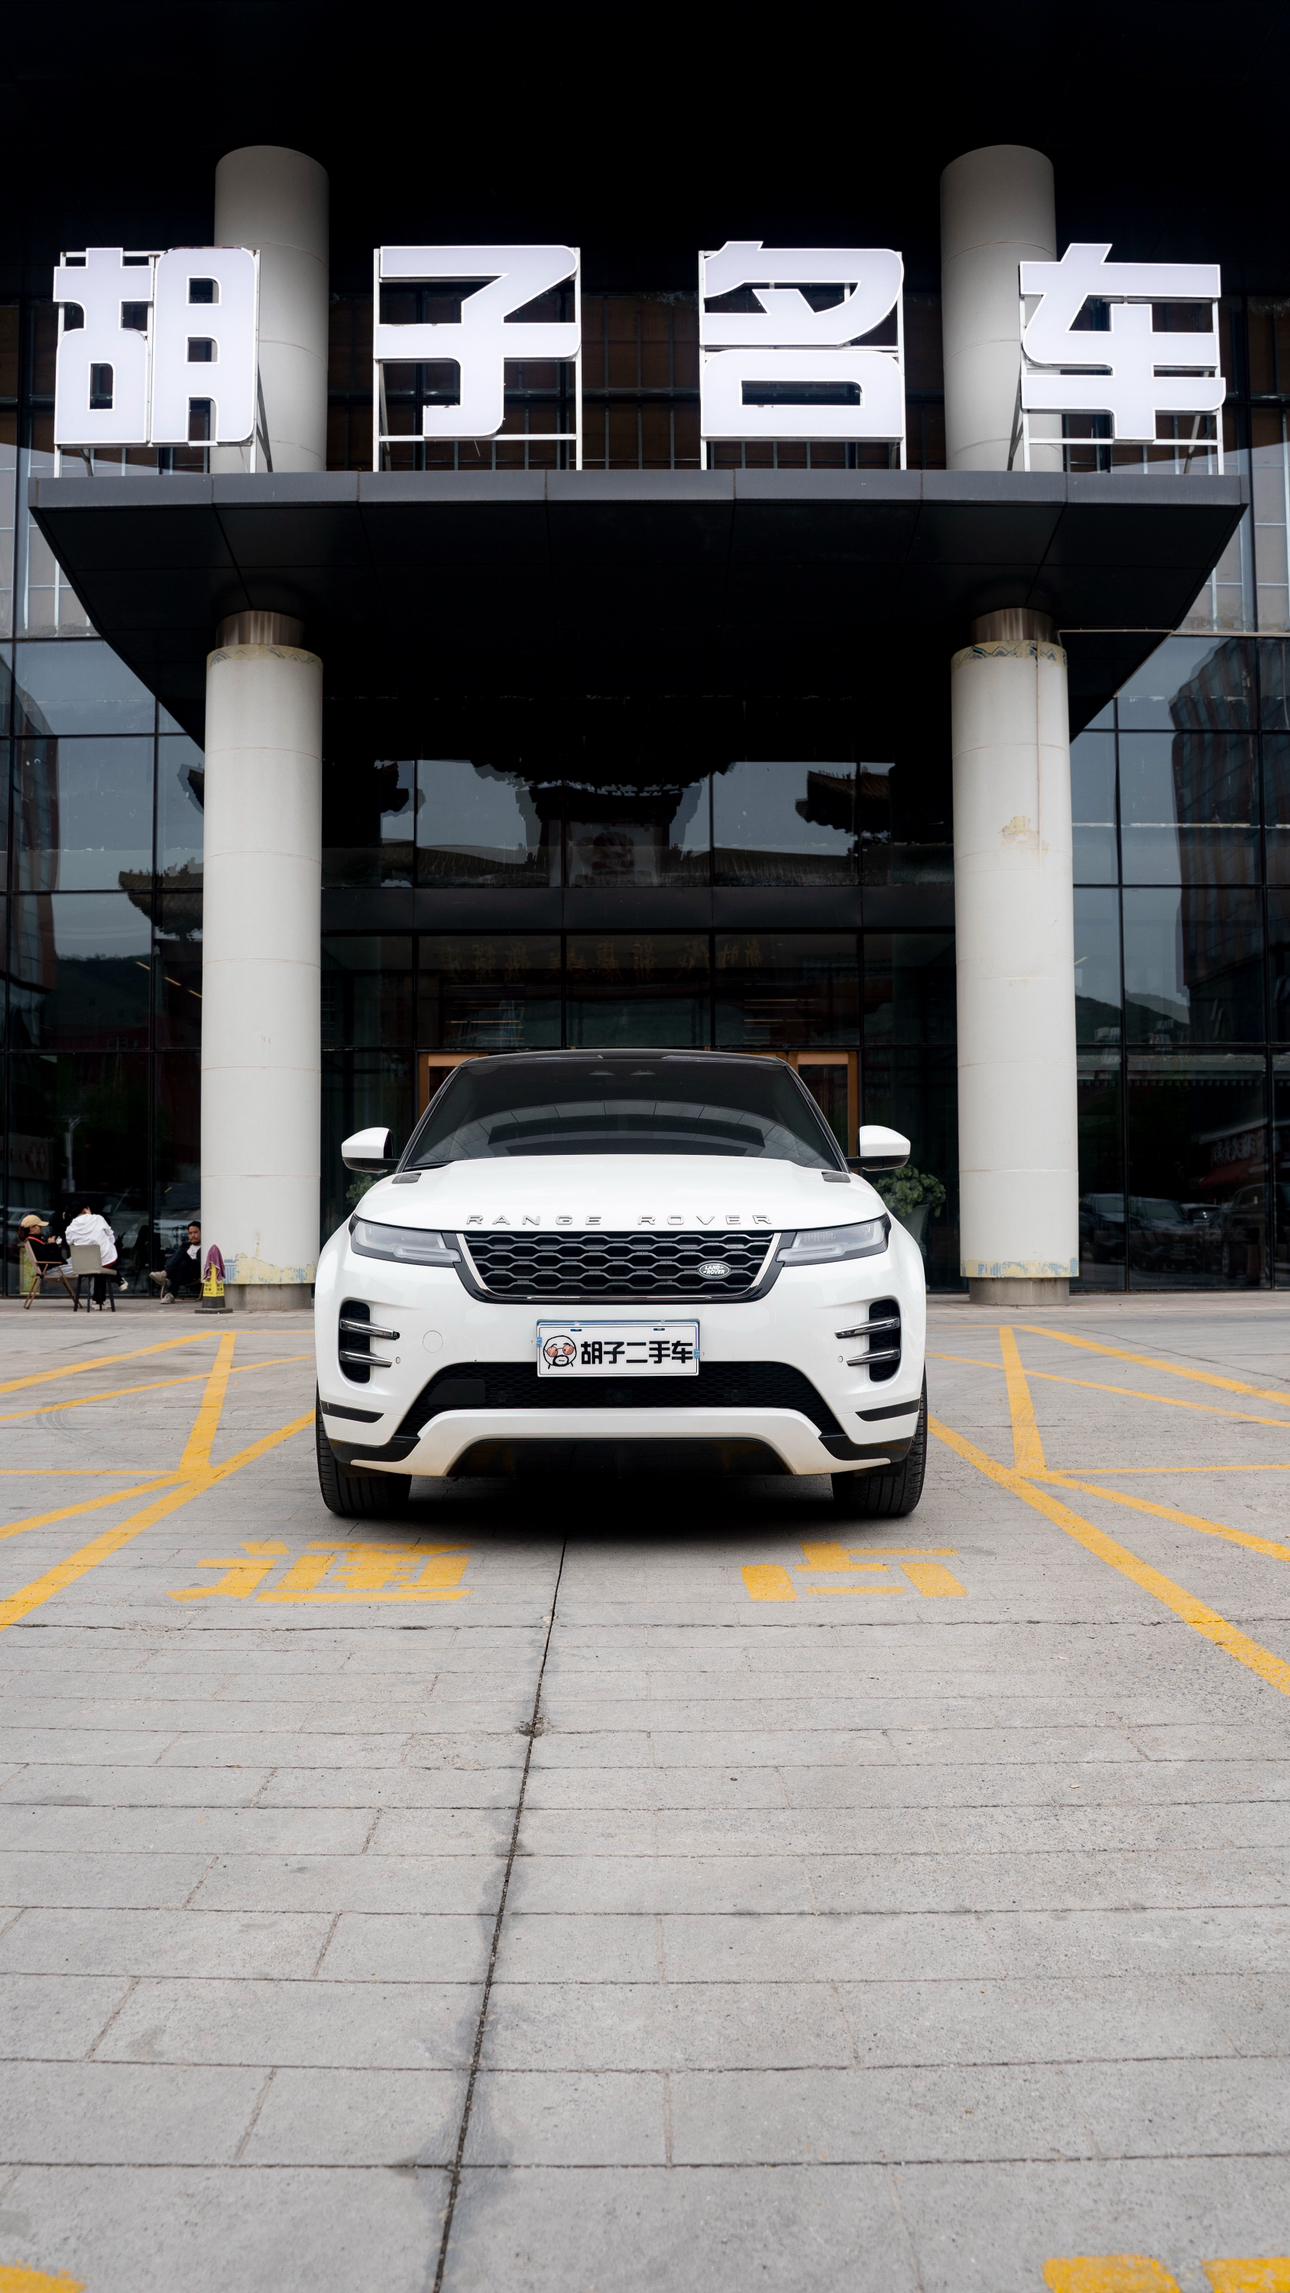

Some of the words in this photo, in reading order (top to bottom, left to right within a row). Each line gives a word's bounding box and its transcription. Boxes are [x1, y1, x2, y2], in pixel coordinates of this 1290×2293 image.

[53, 241, 1226, 445] 胡子名车
[466, 1214, 602, 1226] RANGE
[637, 1214, 772, 1226] ROVER
[580, 1340, 693, 1365] 胡子二手车
